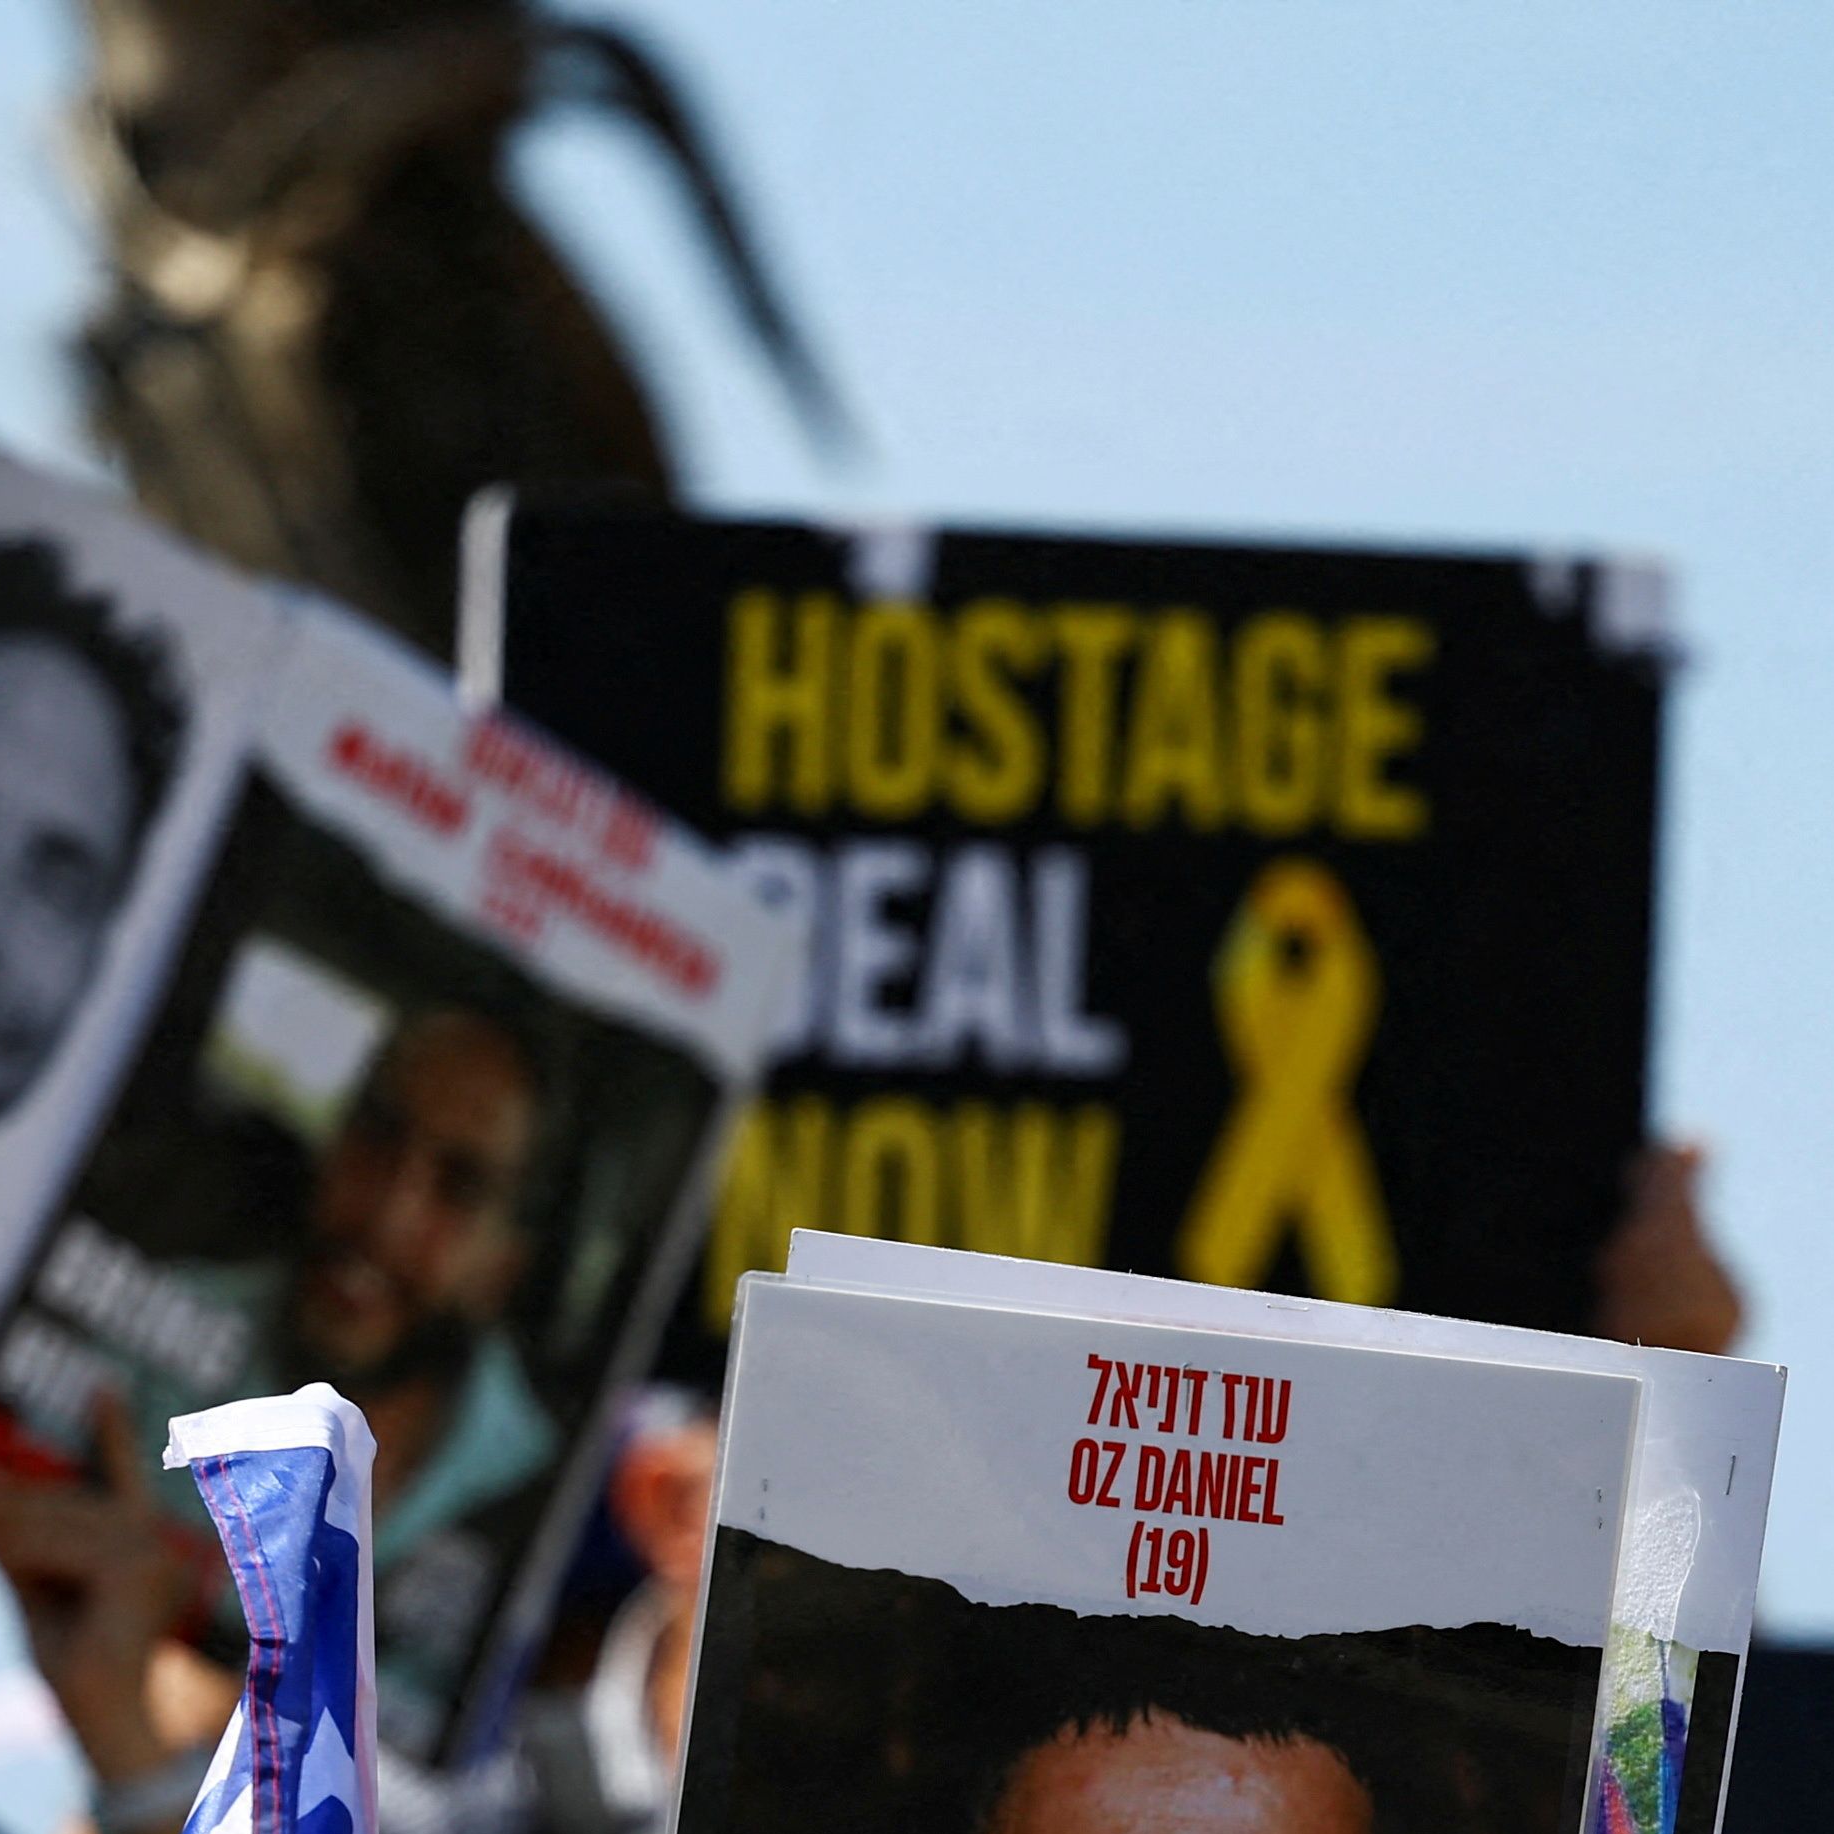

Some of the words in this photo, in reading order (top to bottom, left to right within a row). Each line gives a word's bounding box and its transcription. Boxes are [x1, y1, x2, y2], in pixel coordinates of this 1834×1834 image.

[719, 592, 1435, 840] HOSTAGE
[702, 1098, 1125, 1338] NOW
[1087, 1352, 1209, 1436] דניאל
[1213, 1372, 1292, 1445] עוז
[1067, 1438, 1127, 1508] OZ
[1133, 1445, 1285, 1526] DANIEL
[1125, 1520, 1210, 1605] (19)
